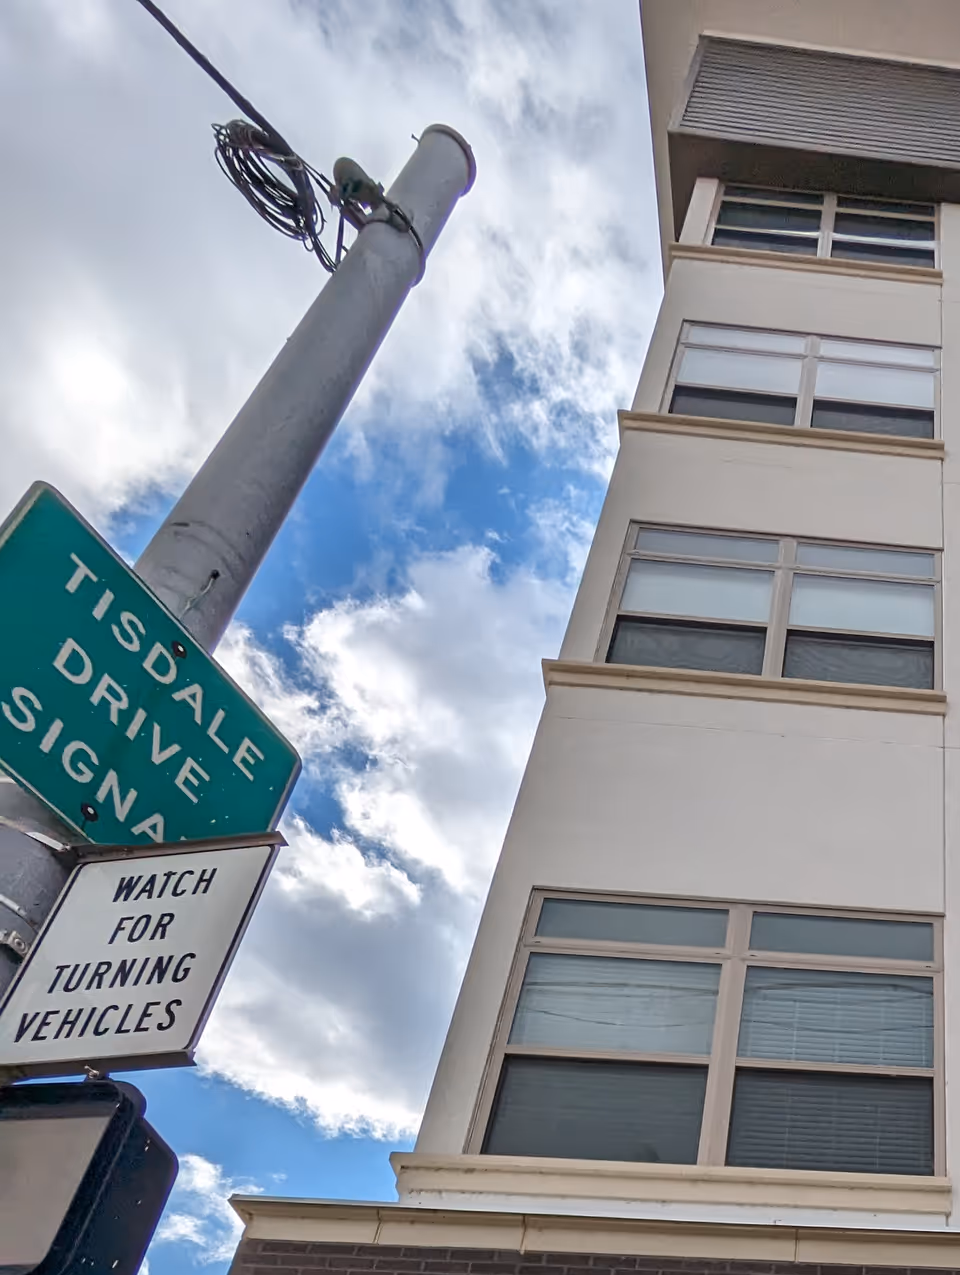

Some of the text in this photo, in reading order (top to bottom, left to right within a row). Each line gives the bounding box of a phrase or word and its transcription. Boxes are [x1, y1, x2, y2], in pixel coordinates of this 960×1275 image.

[65, 552, 264, 781] TISDALE
[52, 638, 210, 804] DRIVE
[2, 687, 188, 843] SIGNA
[112, 868, 218, 903] WATCH
[107, 912, 175, 945] FOR
[47, 952, 196, 994] TURNING
[13, 998, 183, 1043] VEHICLES
